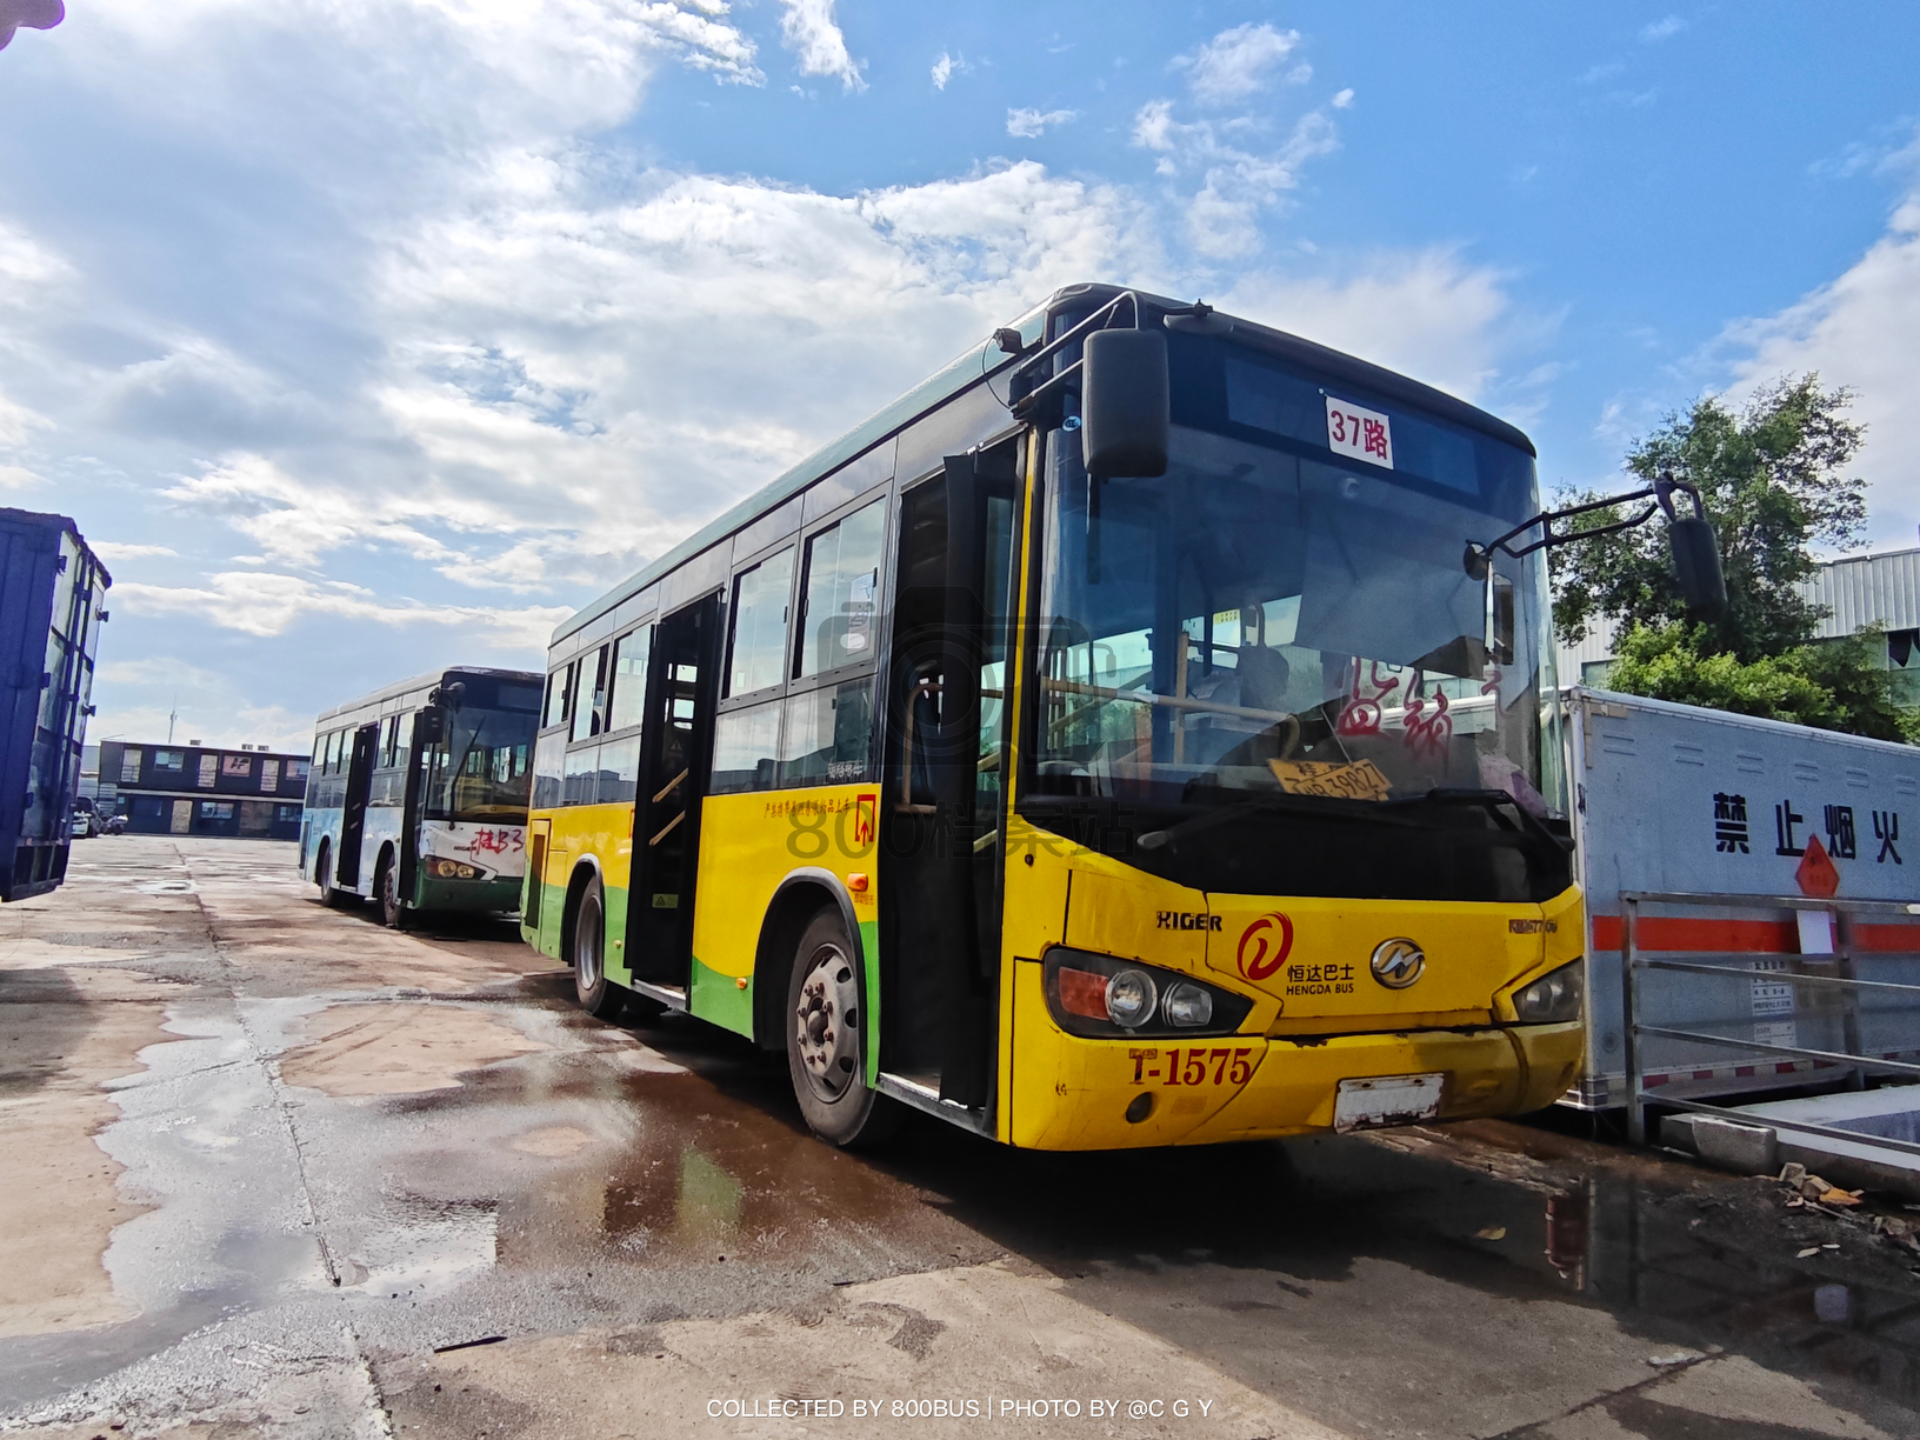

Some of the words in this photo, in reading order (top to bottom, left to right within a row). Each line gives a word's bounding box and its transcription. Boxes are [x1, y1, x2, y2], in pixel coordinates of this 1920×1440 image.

[1331, 410, 1387, 460] 37路
[1713, 792, 1902, 865] 禁止烟火
[1286, 984, 1331, 996] HENGDA
[1335, 983, 1354, 994] BUS
[1287, 963, 1355, 983] 恒达巴士
[1129, 1048, 1252, 1086] T-1575
